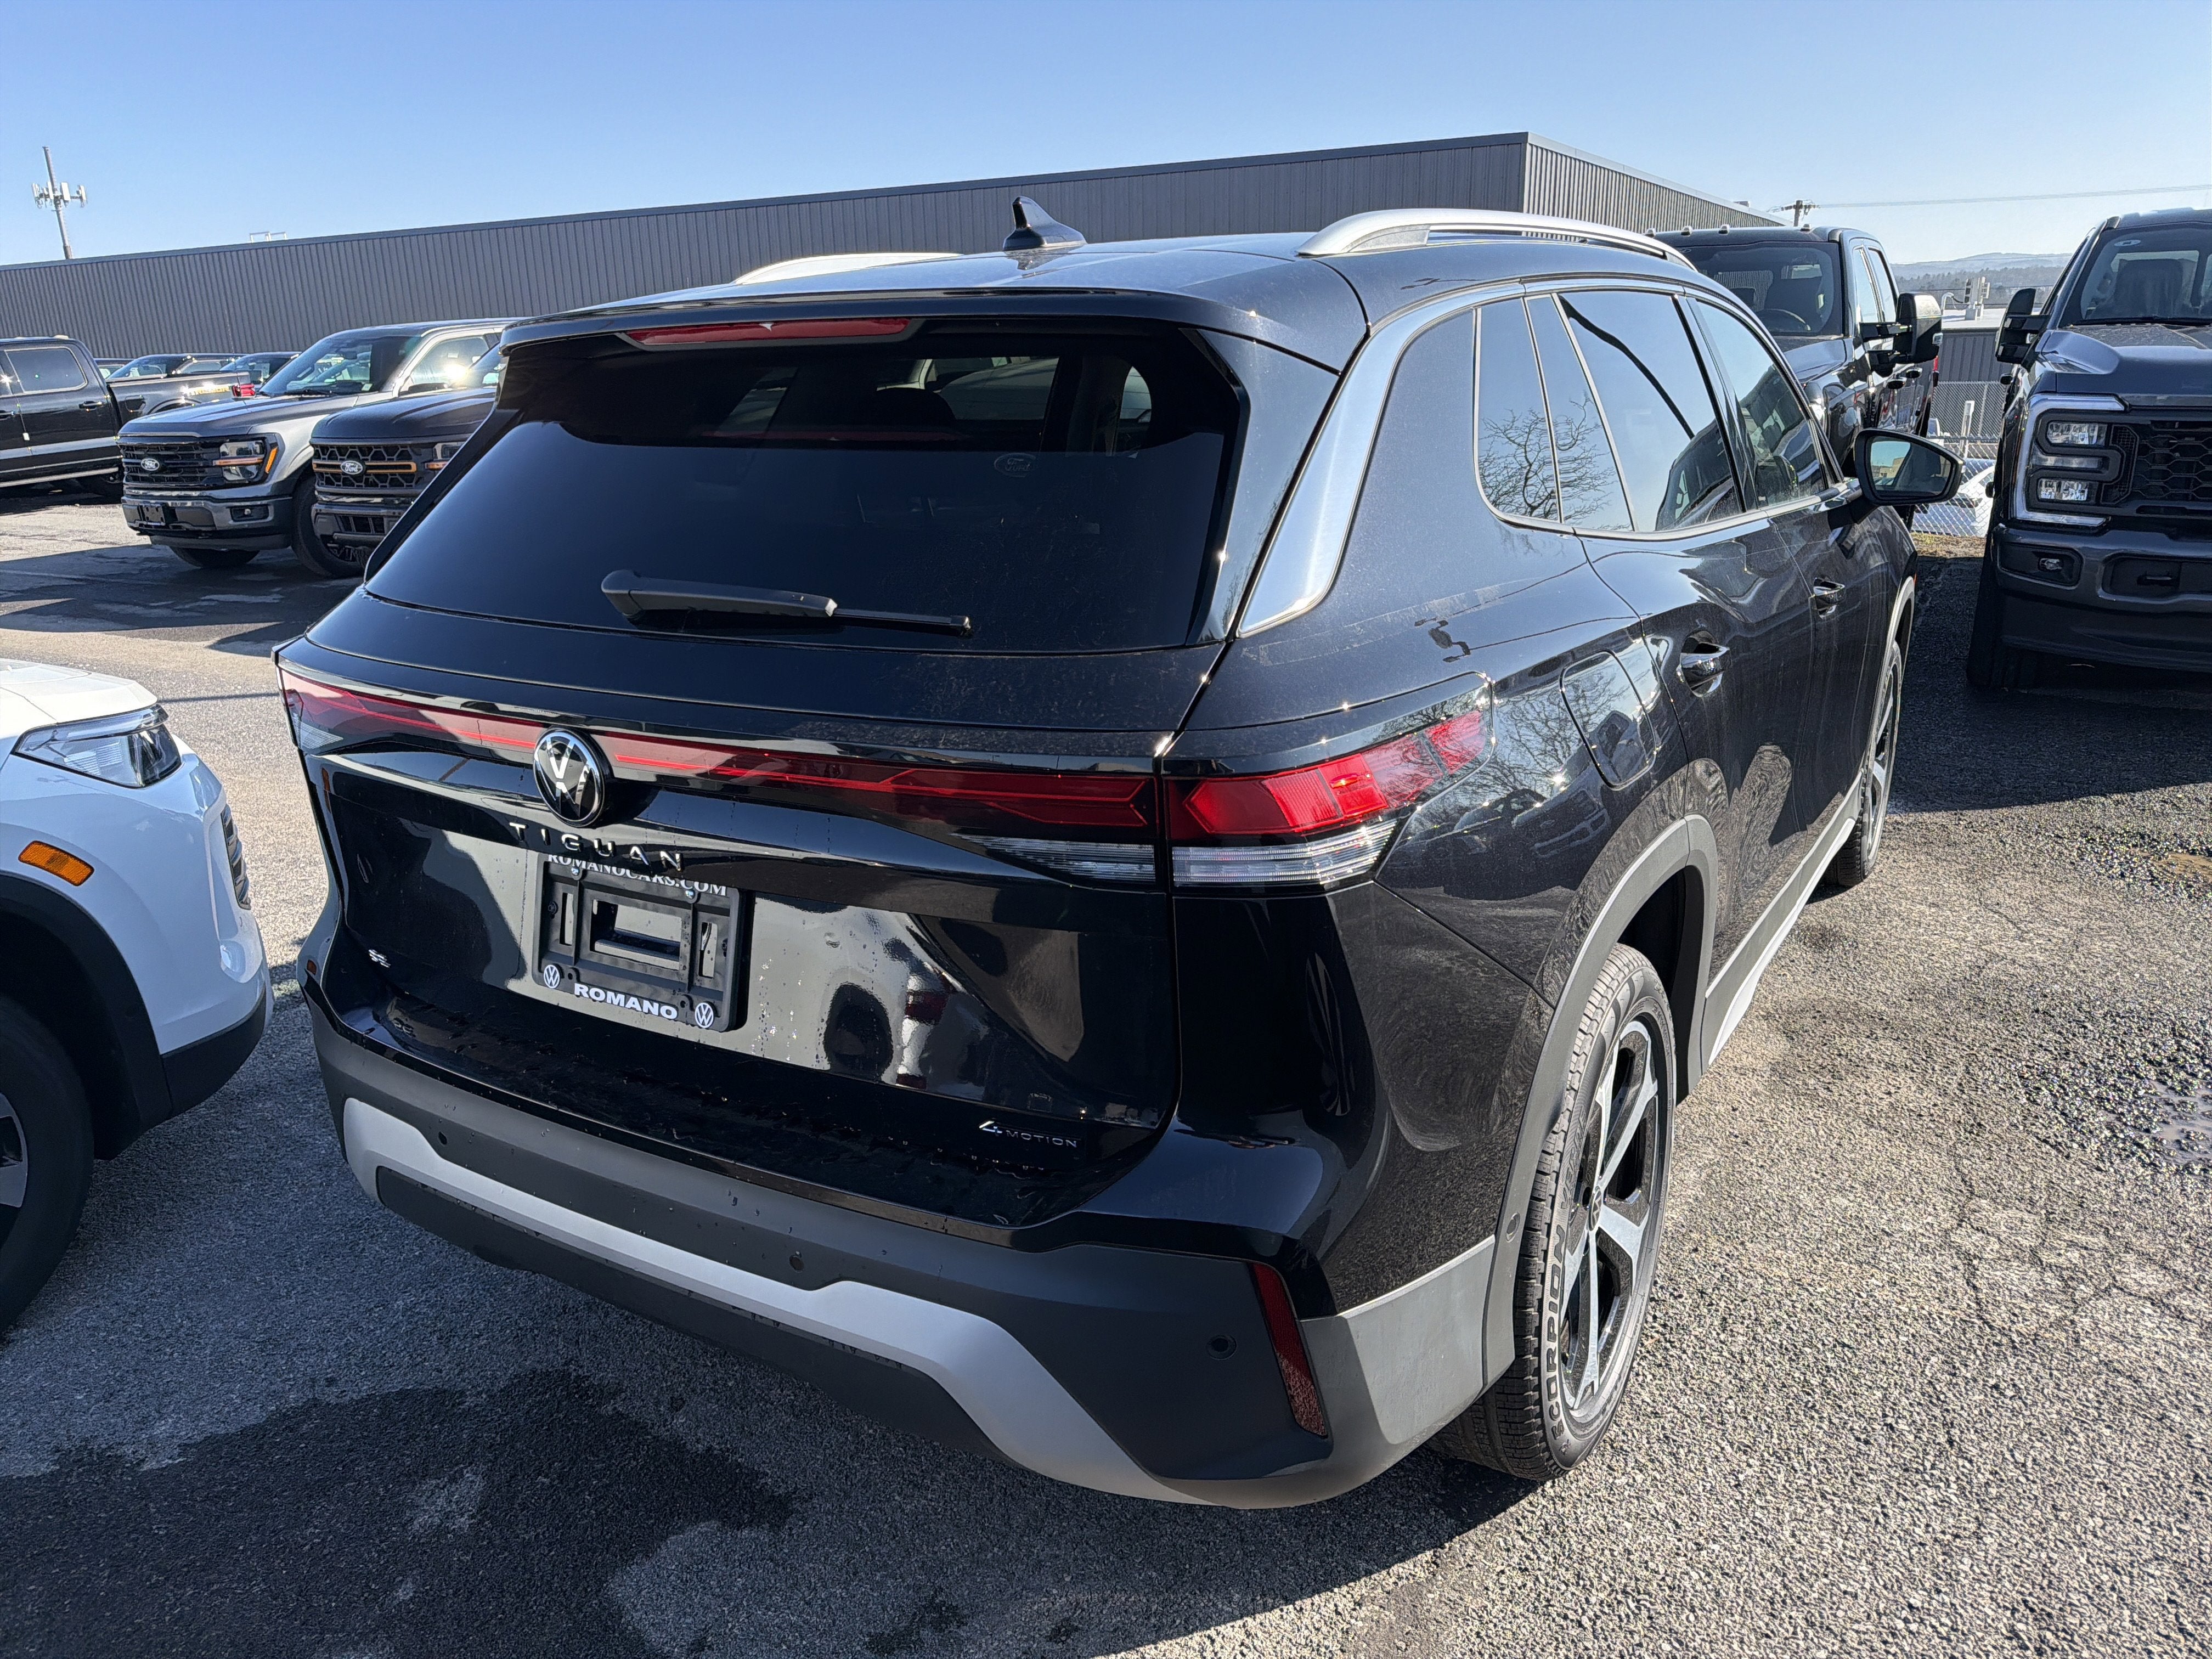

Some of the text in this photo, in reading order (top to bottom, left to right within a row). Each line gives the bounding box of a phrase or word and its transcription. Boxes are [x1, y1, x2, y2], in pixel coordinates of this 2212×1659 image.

[345, 462, 358, 472] Ford
[510, 822, 684, 872] TIGUAN
[574, 983, 678, 1020] ROMANO
[1546, 1223, 1565, 1441] SCORPION
